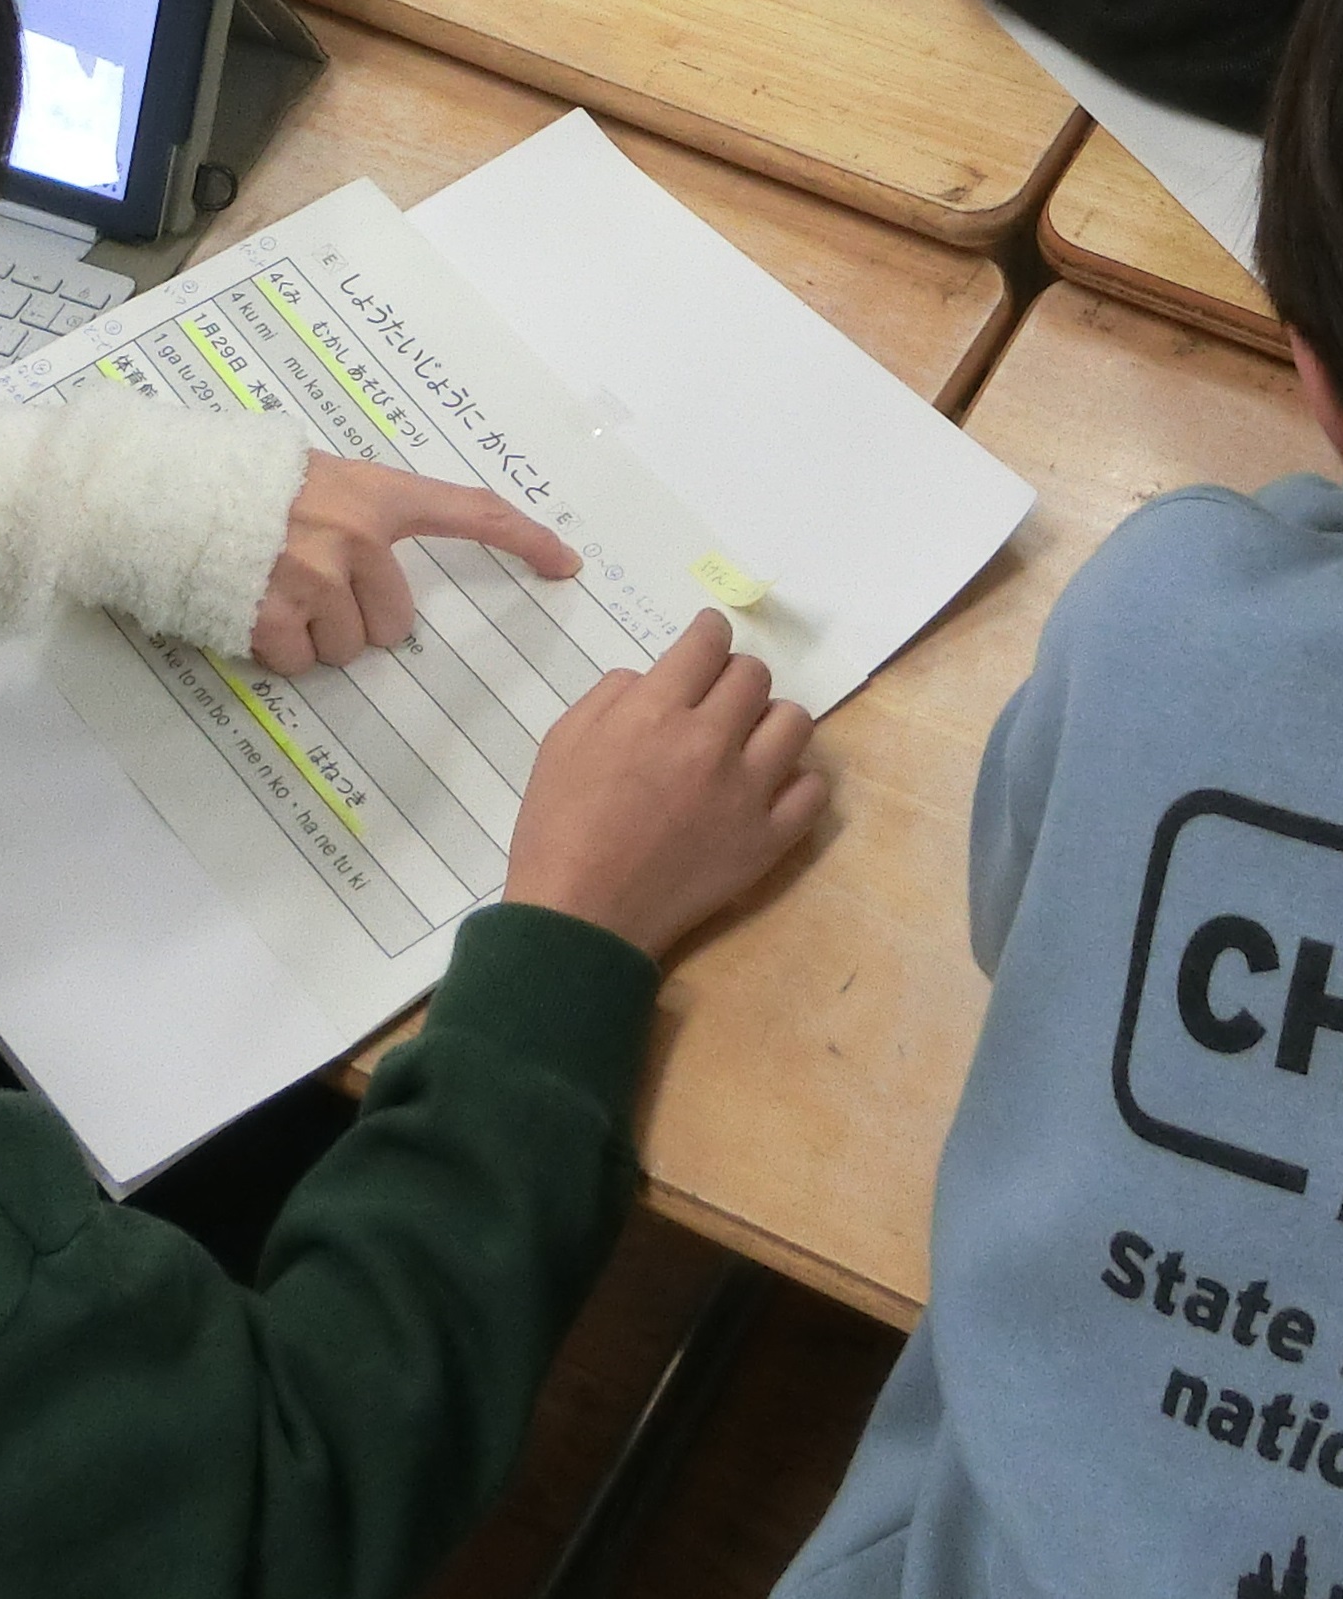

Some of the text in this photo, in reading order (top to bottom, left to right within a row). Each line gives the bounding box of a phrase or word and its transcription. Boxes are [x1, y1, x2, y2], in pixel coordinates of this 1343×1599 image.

[231, 292, 246, 303] 4
[238, 302, 260, 322] ku
[153, 333, 168, 343] 1
[254, 322, 278, 341] mi
[158, 344, 182, 365] ga
[193, 313, 291, 417] 1月29日 木曜
[270, 272, 429, 448] 4くみ むかし あそび まつり
[177, 364, 196, 381] tu
[283, 357, 308, 381] mu
[190, 380, 215, 401] 29
[304, 378, 324, 400] ka
[340, 273, 486, 431] しょうたいじょうに
[477, 431, 551, 504] かくこと
[320, 401, 341, 415] si
[332, 415, 347, 427] a
[343, 427, 363, 446] so
[162, 648, 182, 669] ke
[178, 669, 196, 687] to
[209, 704, 230, 726] bo
[235, 738, 262, 764] me
[257, 764, 272, 778] n
[268, 777, 290, 799] ko
[296, 810, 318, 833] ha
[314, 834, 336, 856] ne
[333, 855, 354, 875] tu
[347, 871, 372, 892] ki
[307, 744, 366, 808] はねつき
[1100, 1229, 1318, 1364] State
